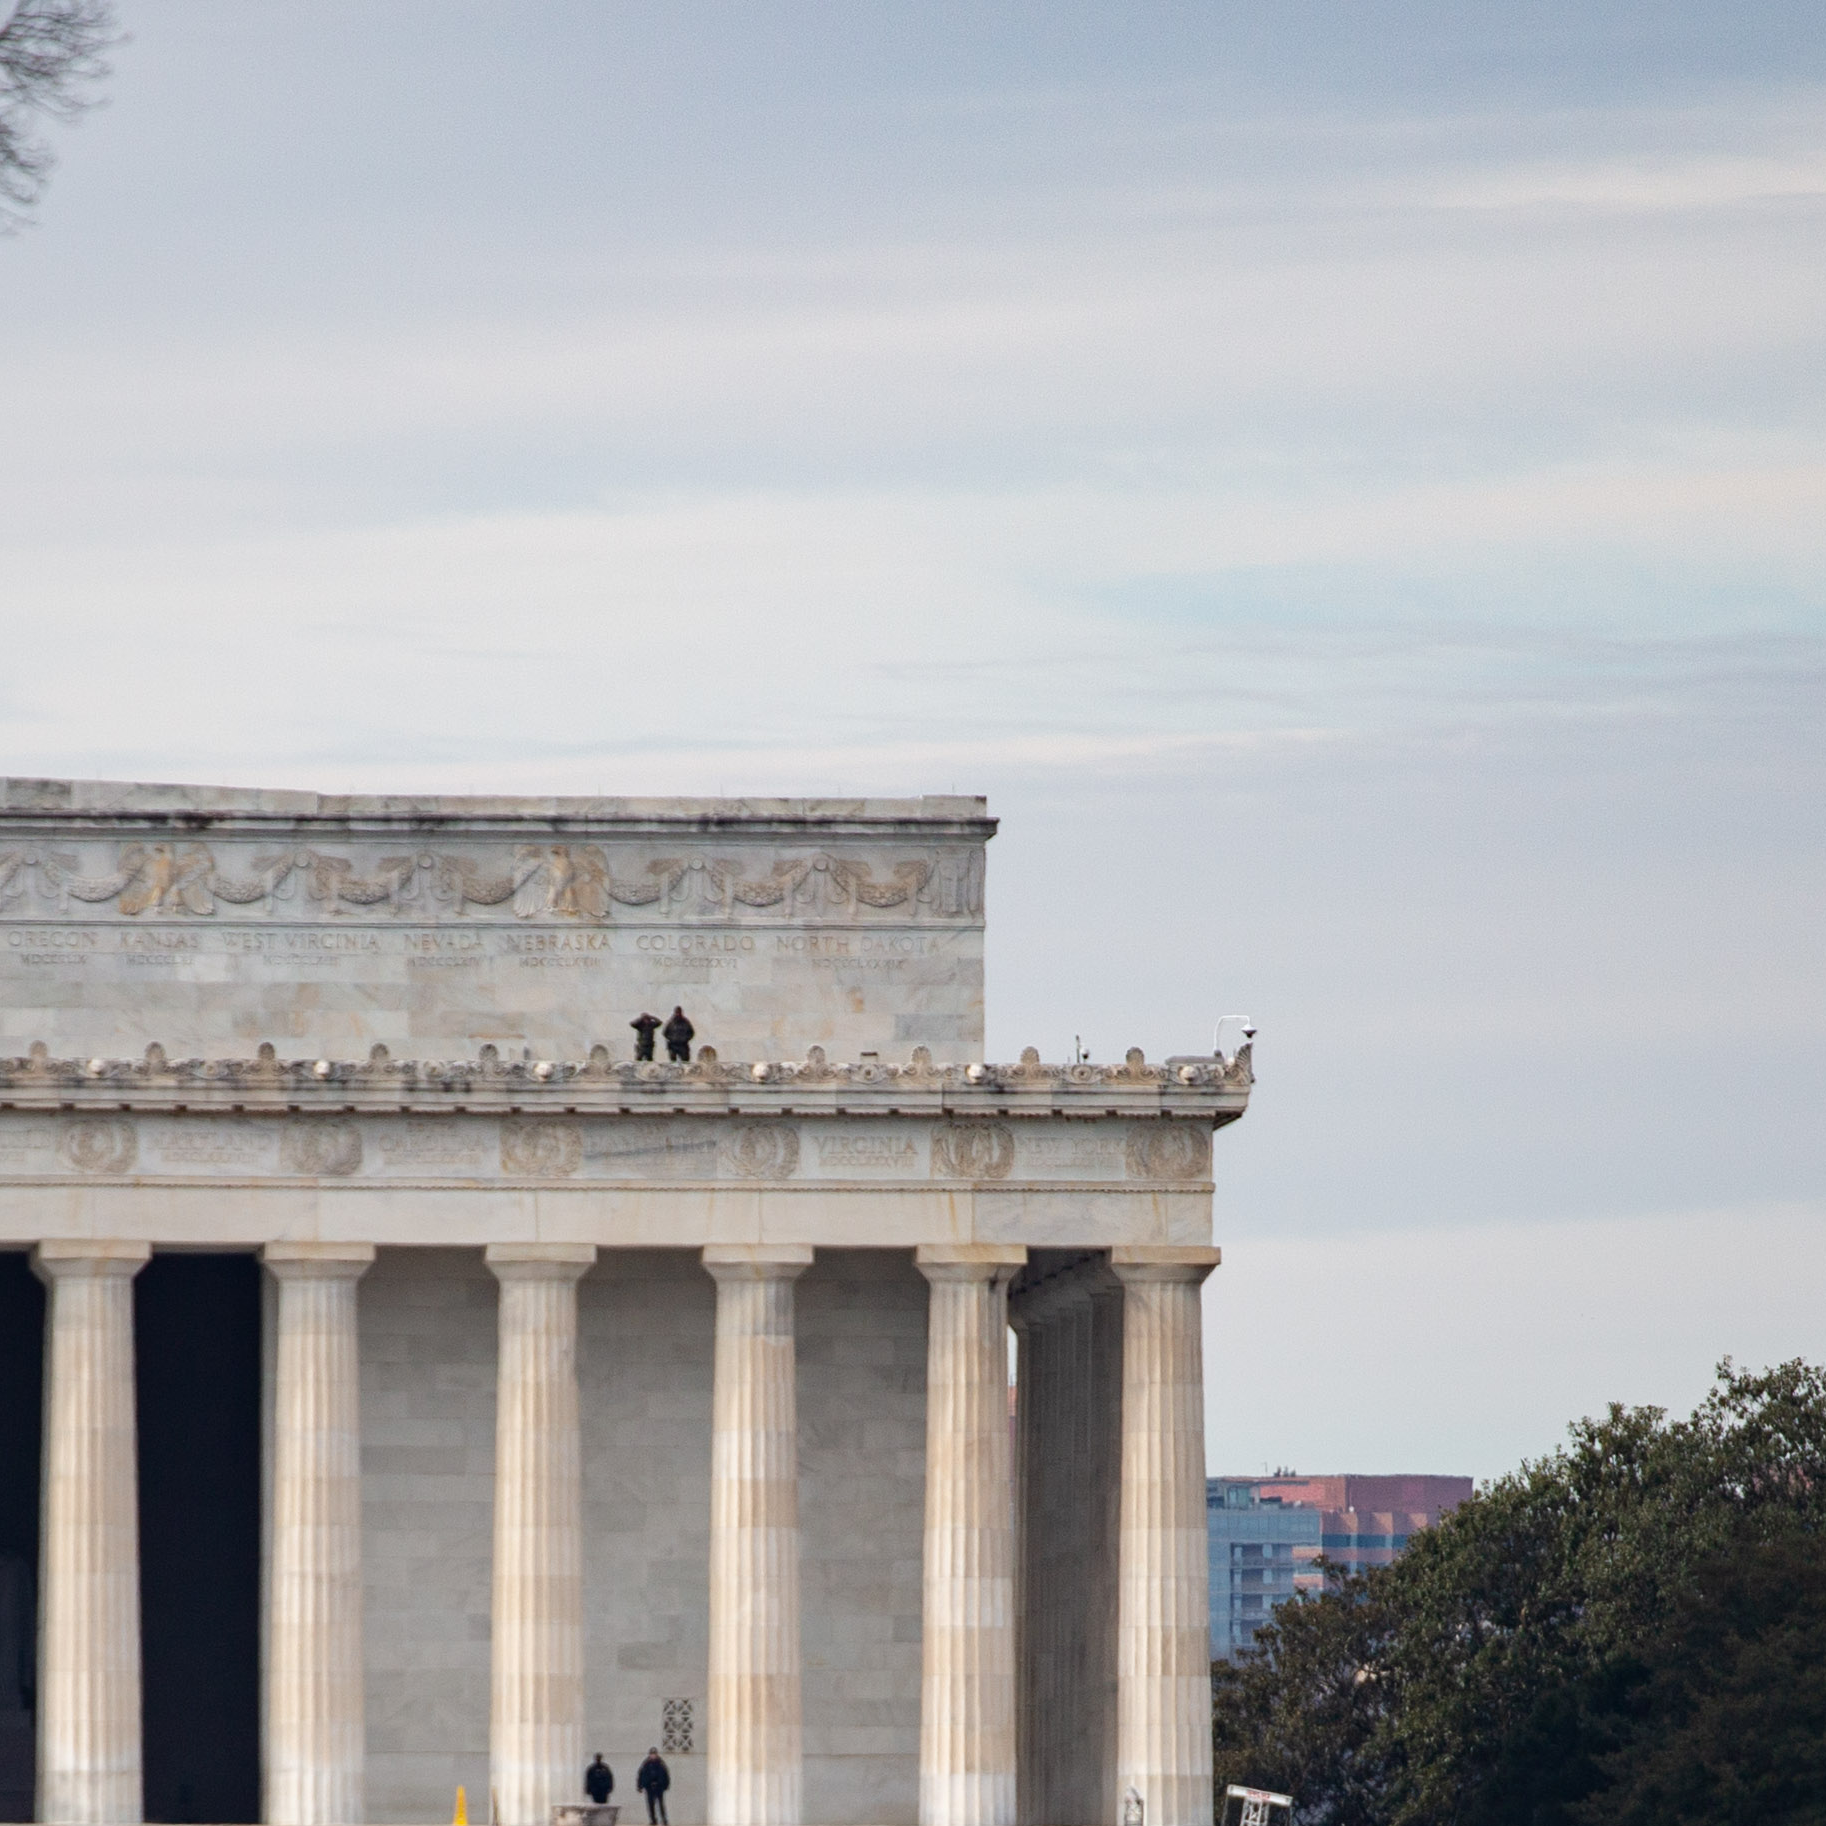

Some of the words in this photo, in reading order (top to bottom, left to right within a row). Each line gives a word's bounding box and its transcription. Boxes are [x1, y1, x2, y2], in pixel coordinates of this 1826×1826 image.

[6, 930, 98, 948] OREGON
[119, 931, 201, 949] KANSAS
[222, 932, 275, 950] WEST
[282, 932, 381, 950] VIRGINIA
[404, 933, 485, 950] NEVADA
[506, 934, 613, 951] NEBRASKA
[636, 934, 756, 951] COLORADO
[775, 935, 850, 952] NORTH
[860, 935, 940, 952] DAKOTA
[814, 1135, 918, 1154] VIRGINIA
